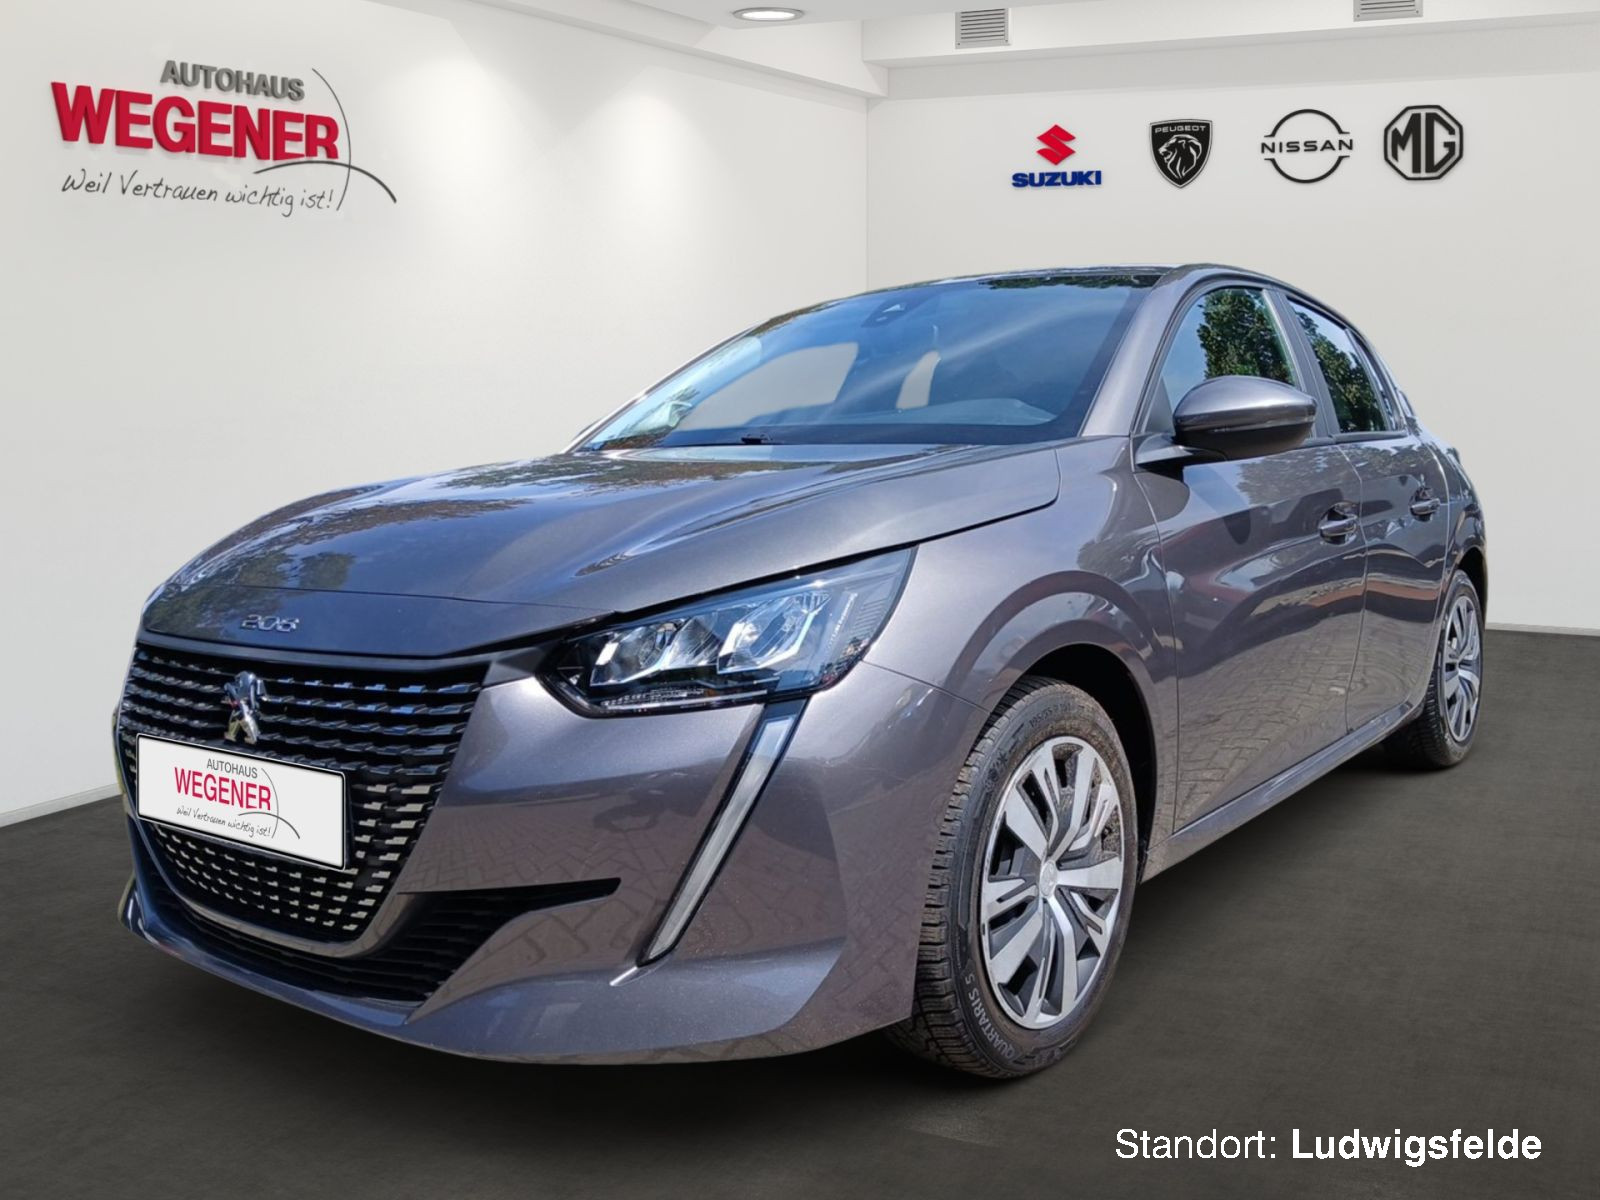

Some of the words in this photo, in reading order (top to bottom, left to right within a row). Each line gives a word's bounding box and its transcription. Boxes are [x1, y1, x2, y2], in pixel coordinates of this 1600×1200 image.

[160, 60, 305, 101] AUTOHAUS
[51, 81, 339, 161] WEGENER
[1154, 125, 1207, 133] PEUGEOT
[1261, 138, 1353, 154] NISSAN
[1391, 112, 1456, 173] MG
[62, 168, 112, 194] Weil
[120, 169, 218, 202] Vertrauen
[225, 185, 294, 217] wichtig
[300, 190, 334, 210] ist!
[1011, 170, 1102, 188] SUZUKI
[174, 766, 271, 811] WEGENER
[206, 758, 258, 779] AUTOHAUS
[176, 805, 191, 817] Weil
[193, 807, 226, 826] Vertrauen
[227, 818, 255, 838] wichtig
[255, 824, 271, 837] ist!
[968, 987, 1016, 1060] QUARTARIS
